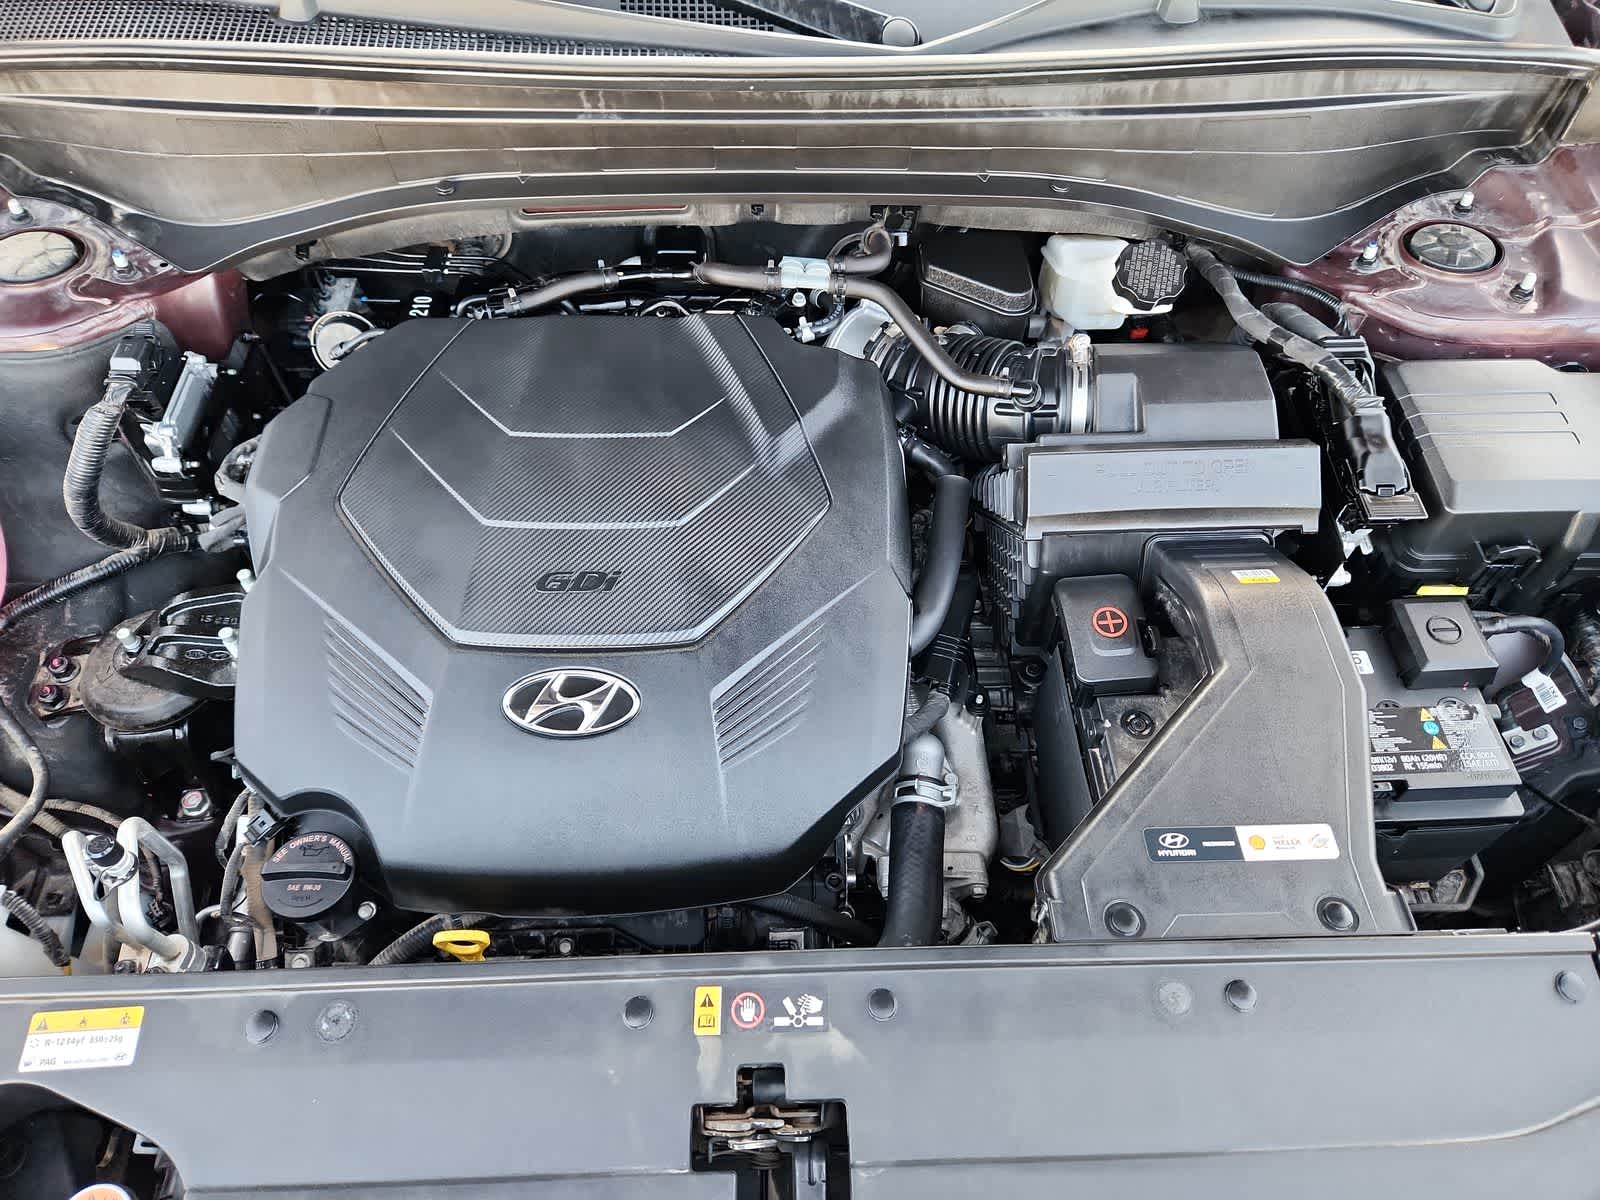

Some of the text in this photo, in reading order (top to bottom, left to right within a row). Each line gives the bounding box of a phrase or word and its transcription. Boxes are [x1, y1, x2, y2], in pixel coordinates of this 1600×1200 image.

[408, 296, 433, 317] 210
[534, 570, 622, 593] GDi
[272, 834, 352, 864] SEE OWNER'S MANUAL
[1157, 849, 1197, 857] HYUNDAI
